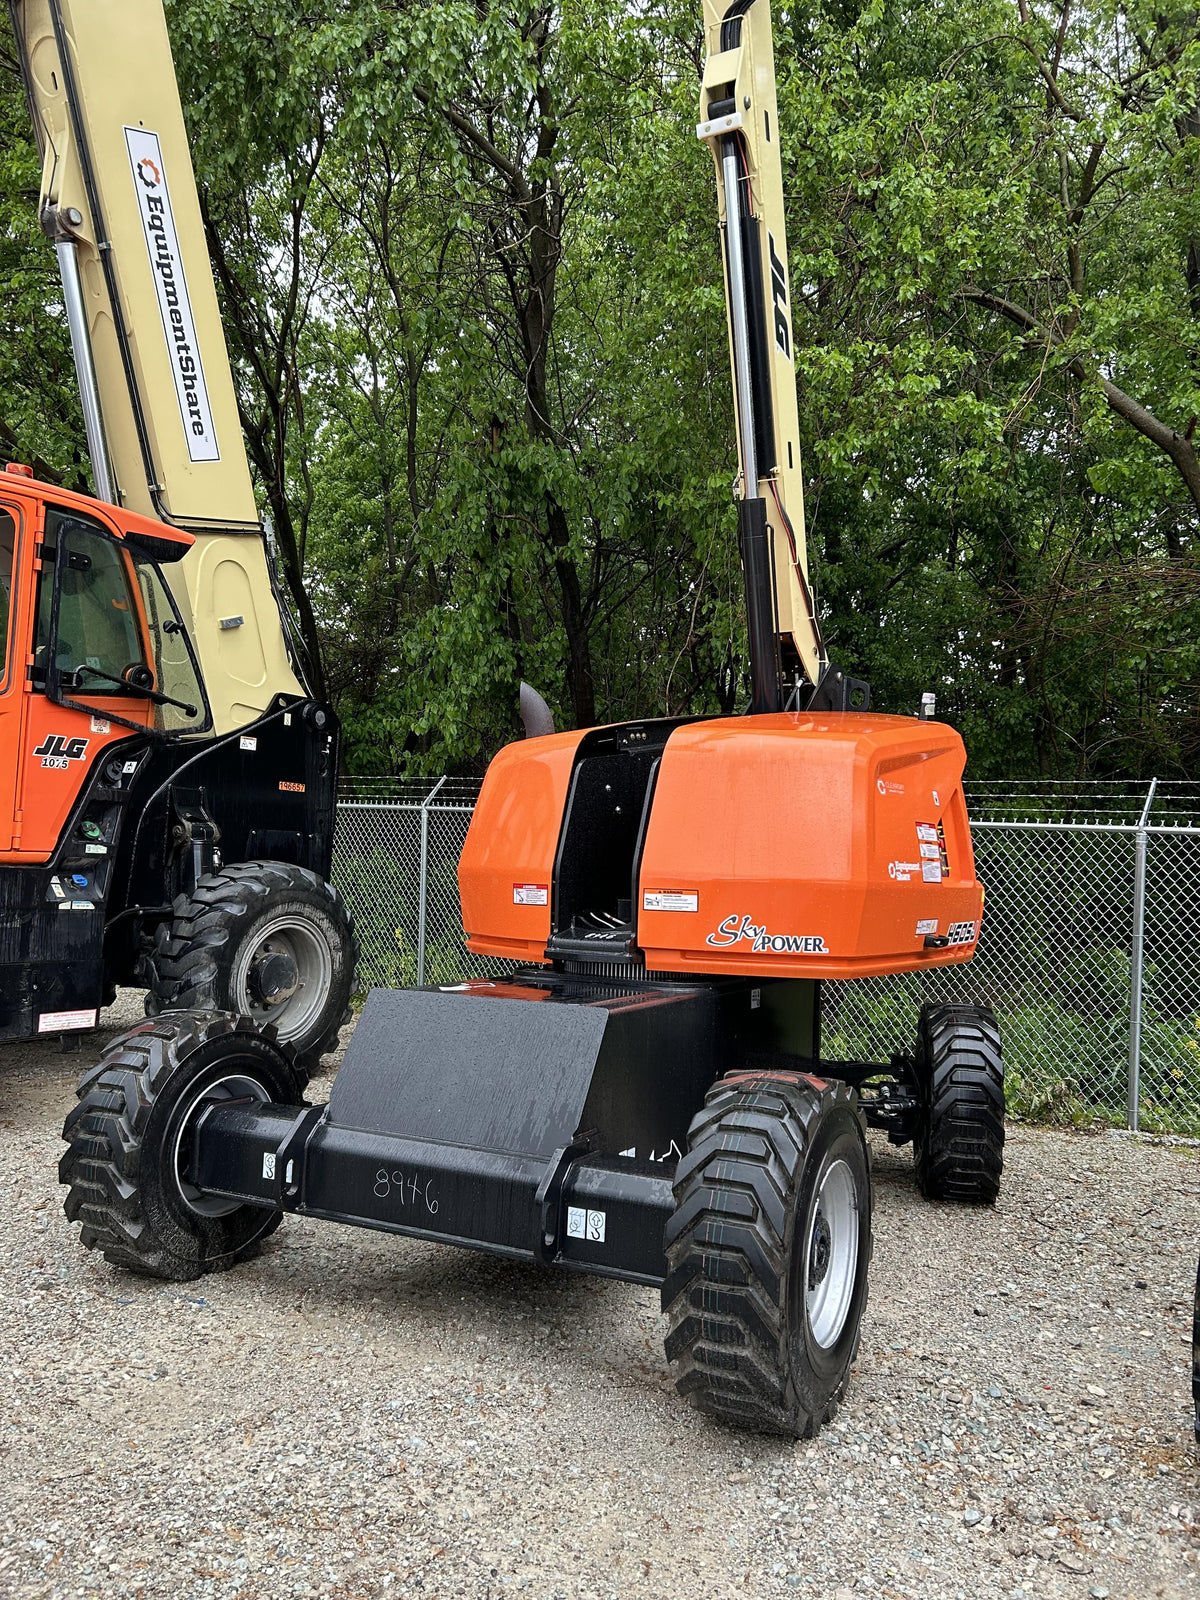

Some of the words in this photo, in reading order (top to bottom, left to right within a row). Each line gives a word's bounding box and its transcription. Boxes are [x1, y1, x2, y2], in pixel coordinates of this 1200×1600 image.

[146, 193, 205, 436] EquipmentShare
[768, 231, 791, 361] JLG
[34, 735, 88, 758] JLG
[42, 758, 68, 769] 1075
[374, 1169, 438, 1214] 8946
